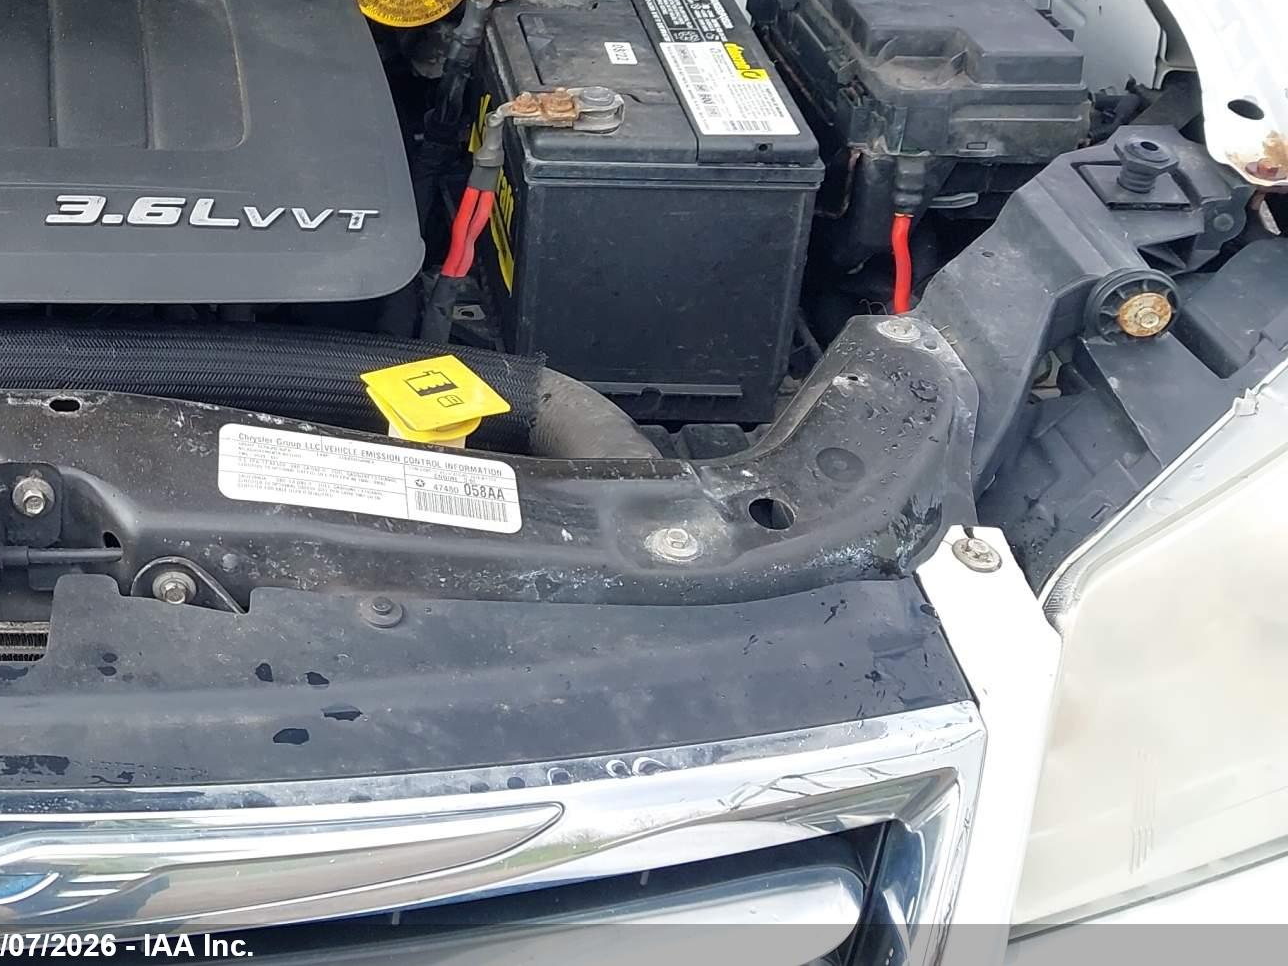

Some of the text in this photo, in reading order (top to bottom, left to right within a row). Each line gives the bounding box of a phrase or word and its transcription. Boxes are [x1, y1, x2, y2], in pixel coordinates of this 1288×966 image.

[238, 432, 273, 445] Chrysler
[276, 437, 302, 450] Group
[324, 445, 356, 456] VEHICLE
[361, 450, 400, 462] EMISSION
[402, 454, 443, 468] CONTROL
[444, 462, 503, 477] INFORMATION
